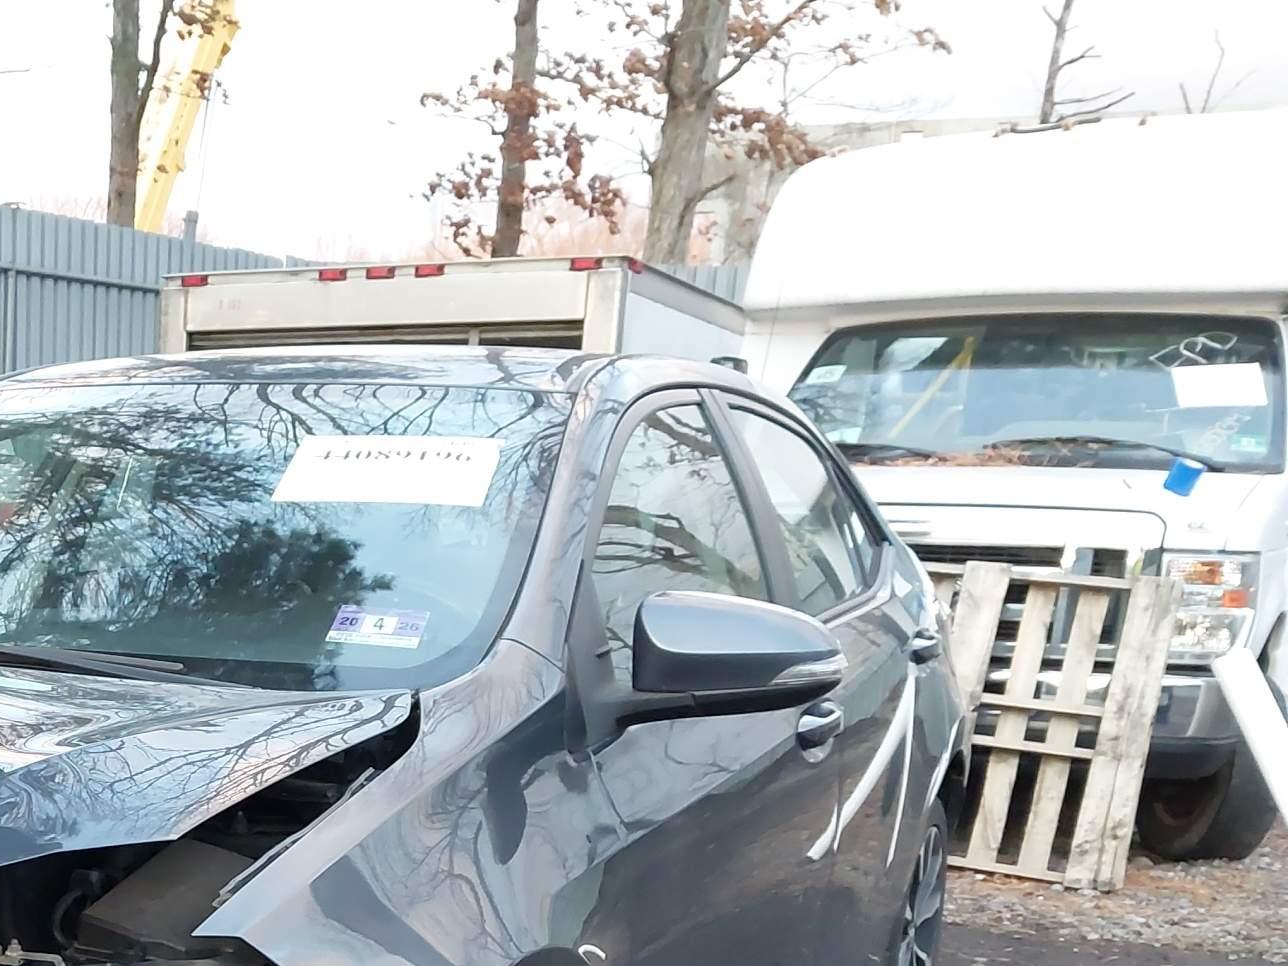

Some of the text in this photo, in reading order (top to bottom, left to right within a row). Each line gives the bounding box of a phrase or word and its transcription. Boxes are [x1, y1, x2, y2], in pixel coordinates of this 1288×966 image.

[338, 616, 420, 632] 20 4 26
